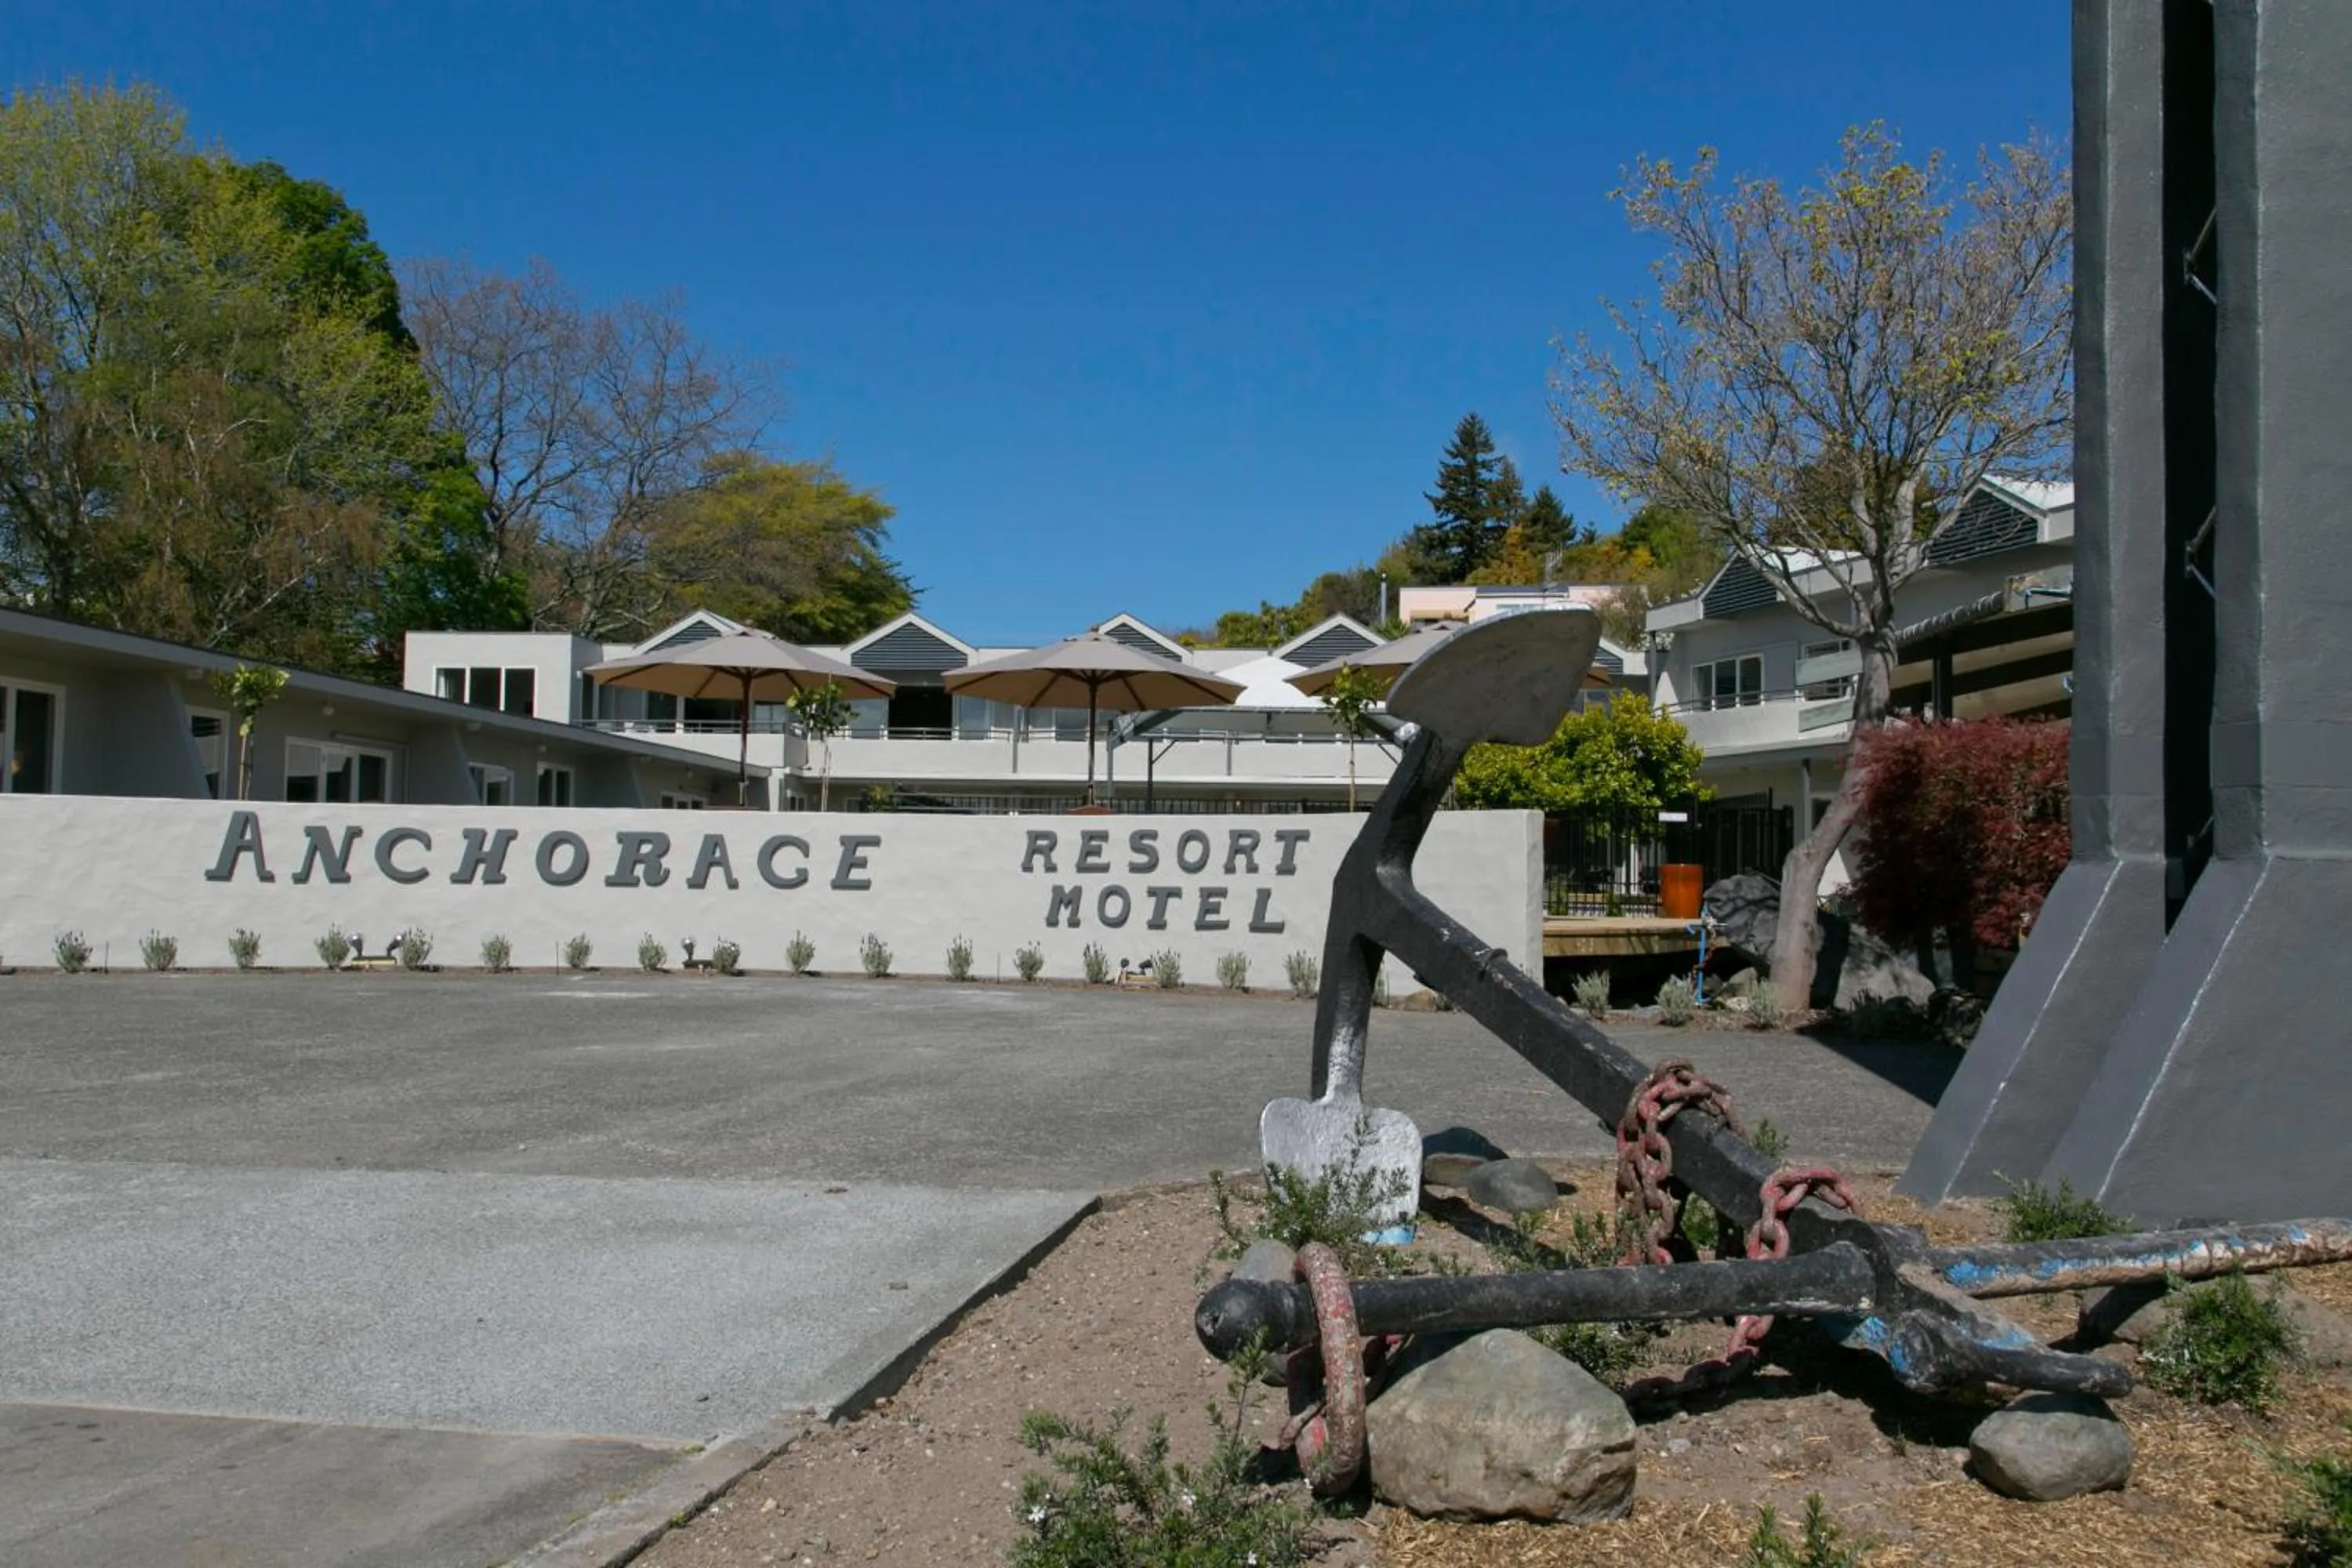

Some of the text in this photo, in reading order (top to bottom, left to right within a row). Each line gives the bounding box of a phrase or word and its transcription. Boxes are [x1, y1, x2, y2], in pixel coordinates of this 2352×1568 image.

[205, 811, 1311, 891] ANCHORAGE RESORT
[1045, 884, 1286, 935] MOTEL
